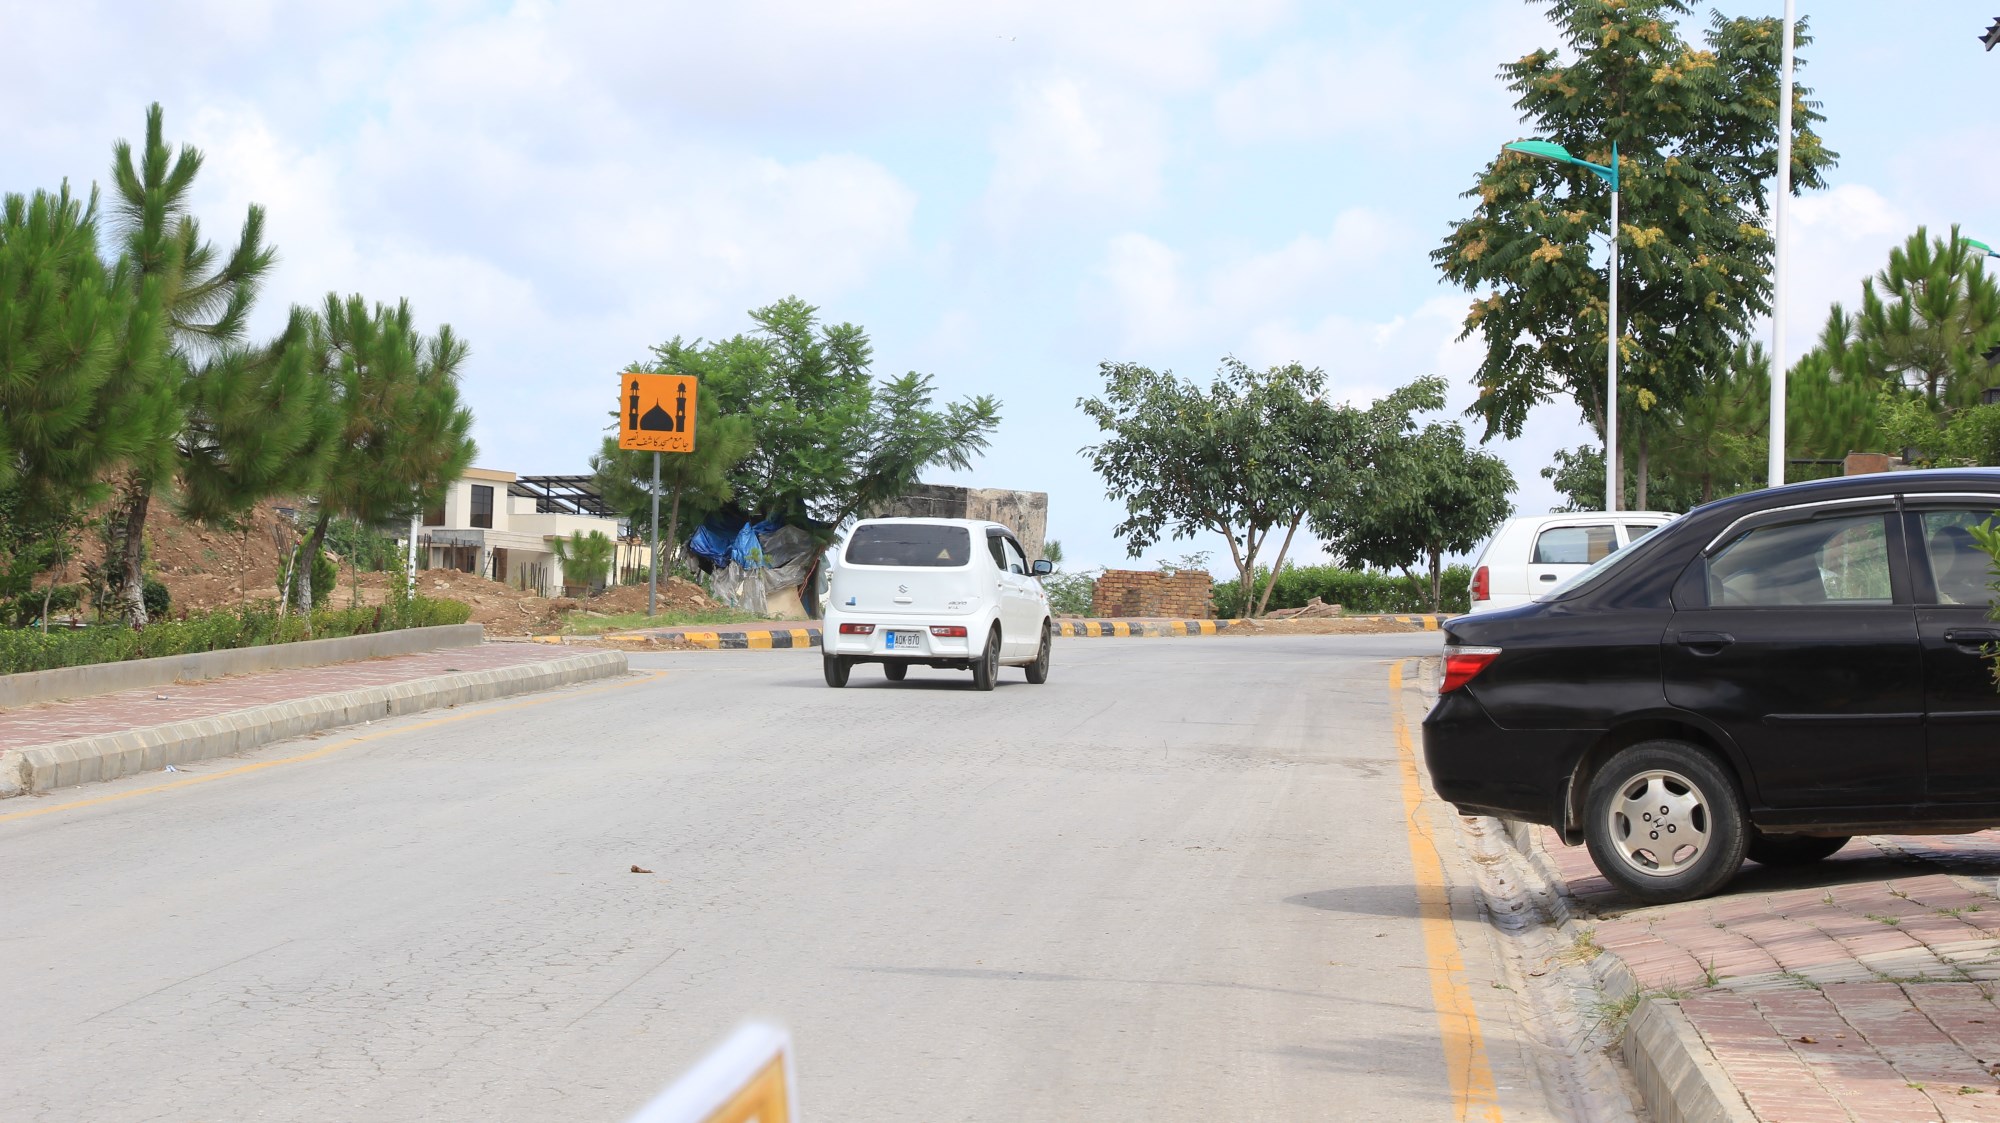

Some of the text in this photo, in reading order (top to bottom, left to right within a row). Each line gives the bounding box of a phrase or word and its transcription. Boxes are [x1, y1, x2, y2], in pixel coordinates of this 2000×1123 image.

[636, 436, 661, 446] کاشف
[658, 437, 673, 449] مسجد
[672, 437, 688, 451] جامع
